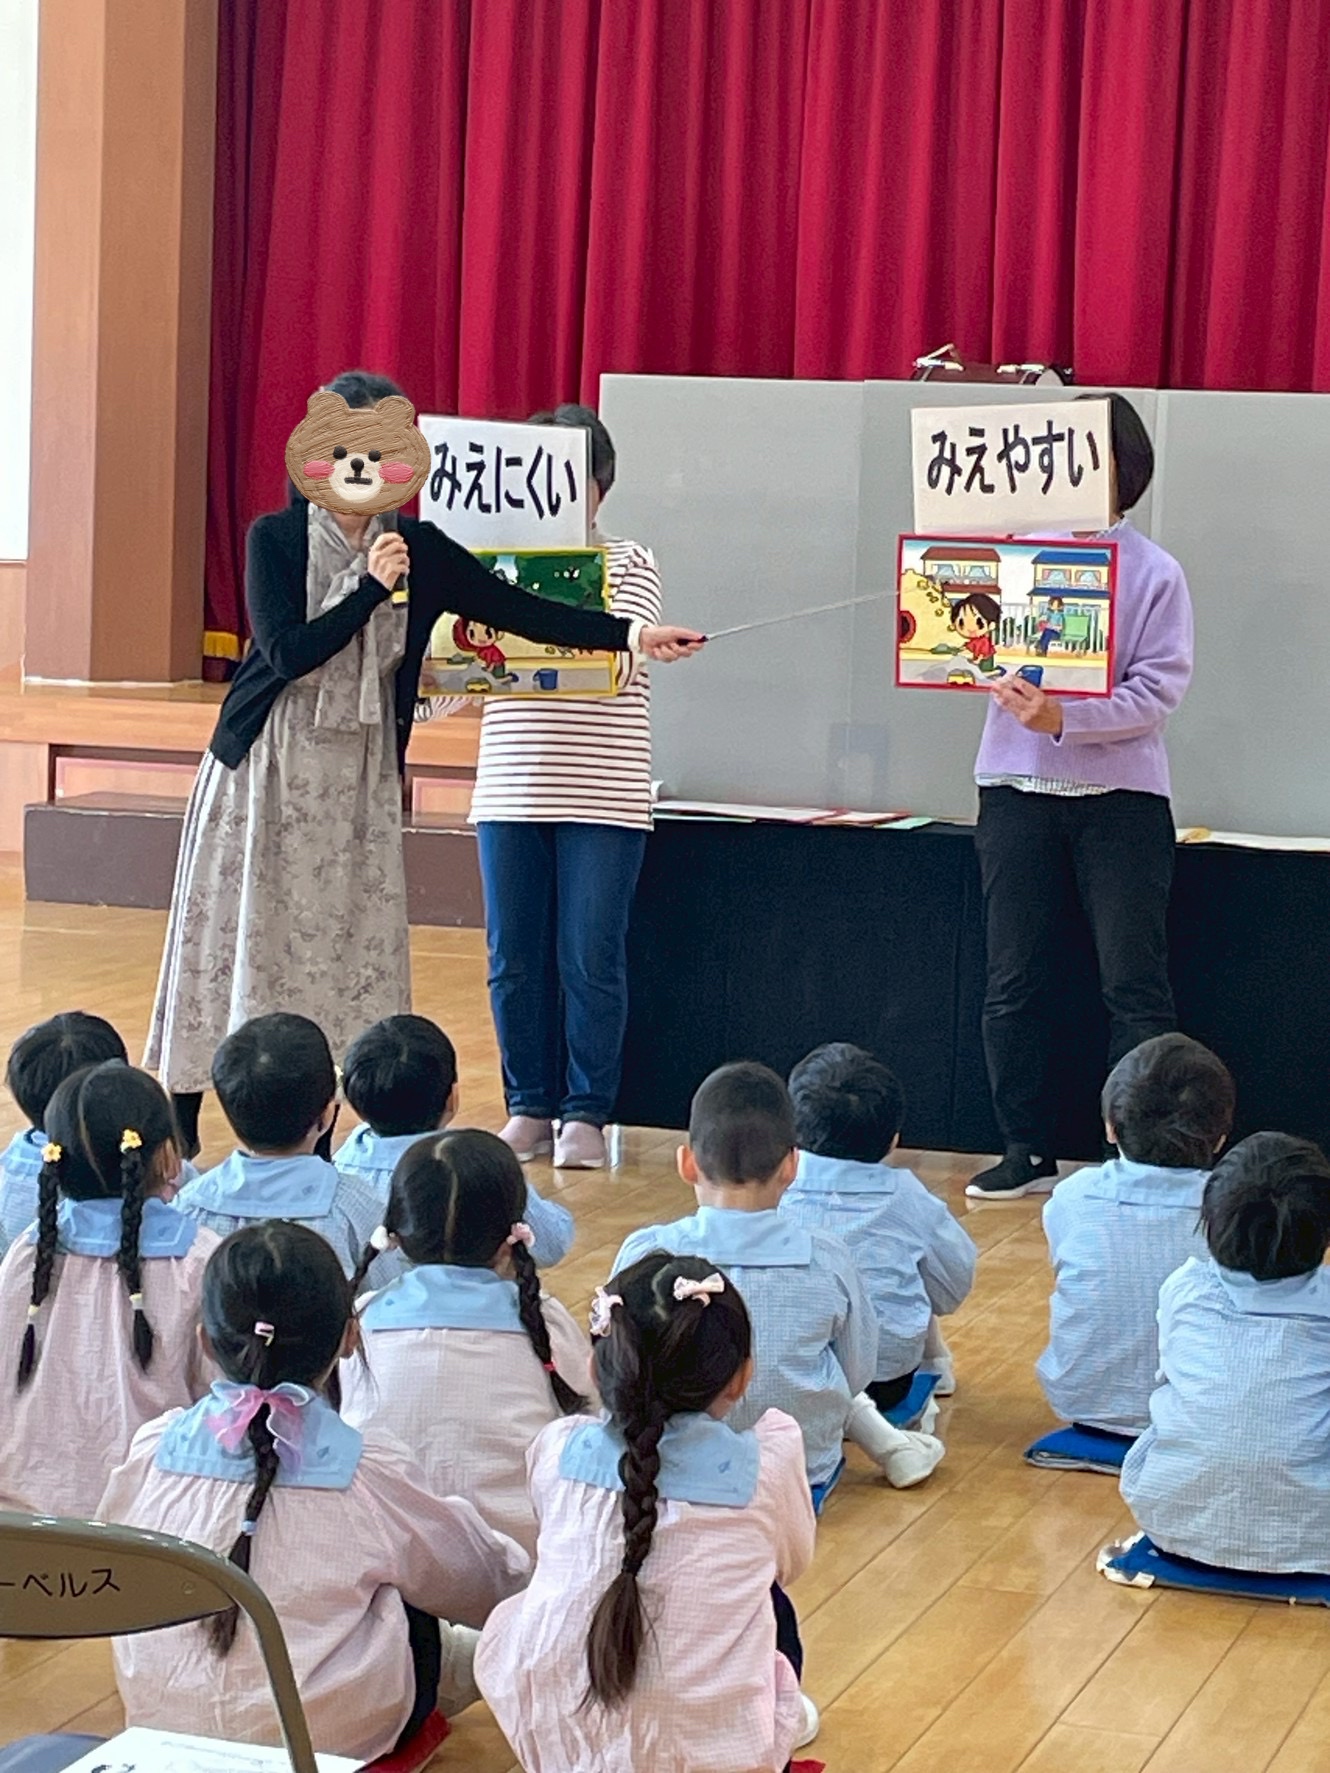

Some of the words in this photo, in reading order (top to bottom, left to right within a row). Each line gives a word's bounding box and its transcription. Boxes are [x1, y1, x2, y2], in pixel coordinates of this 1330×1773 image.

[430, 442, 577, 520] みえにくい
[927, 420, 1100, 495] みえやすい
